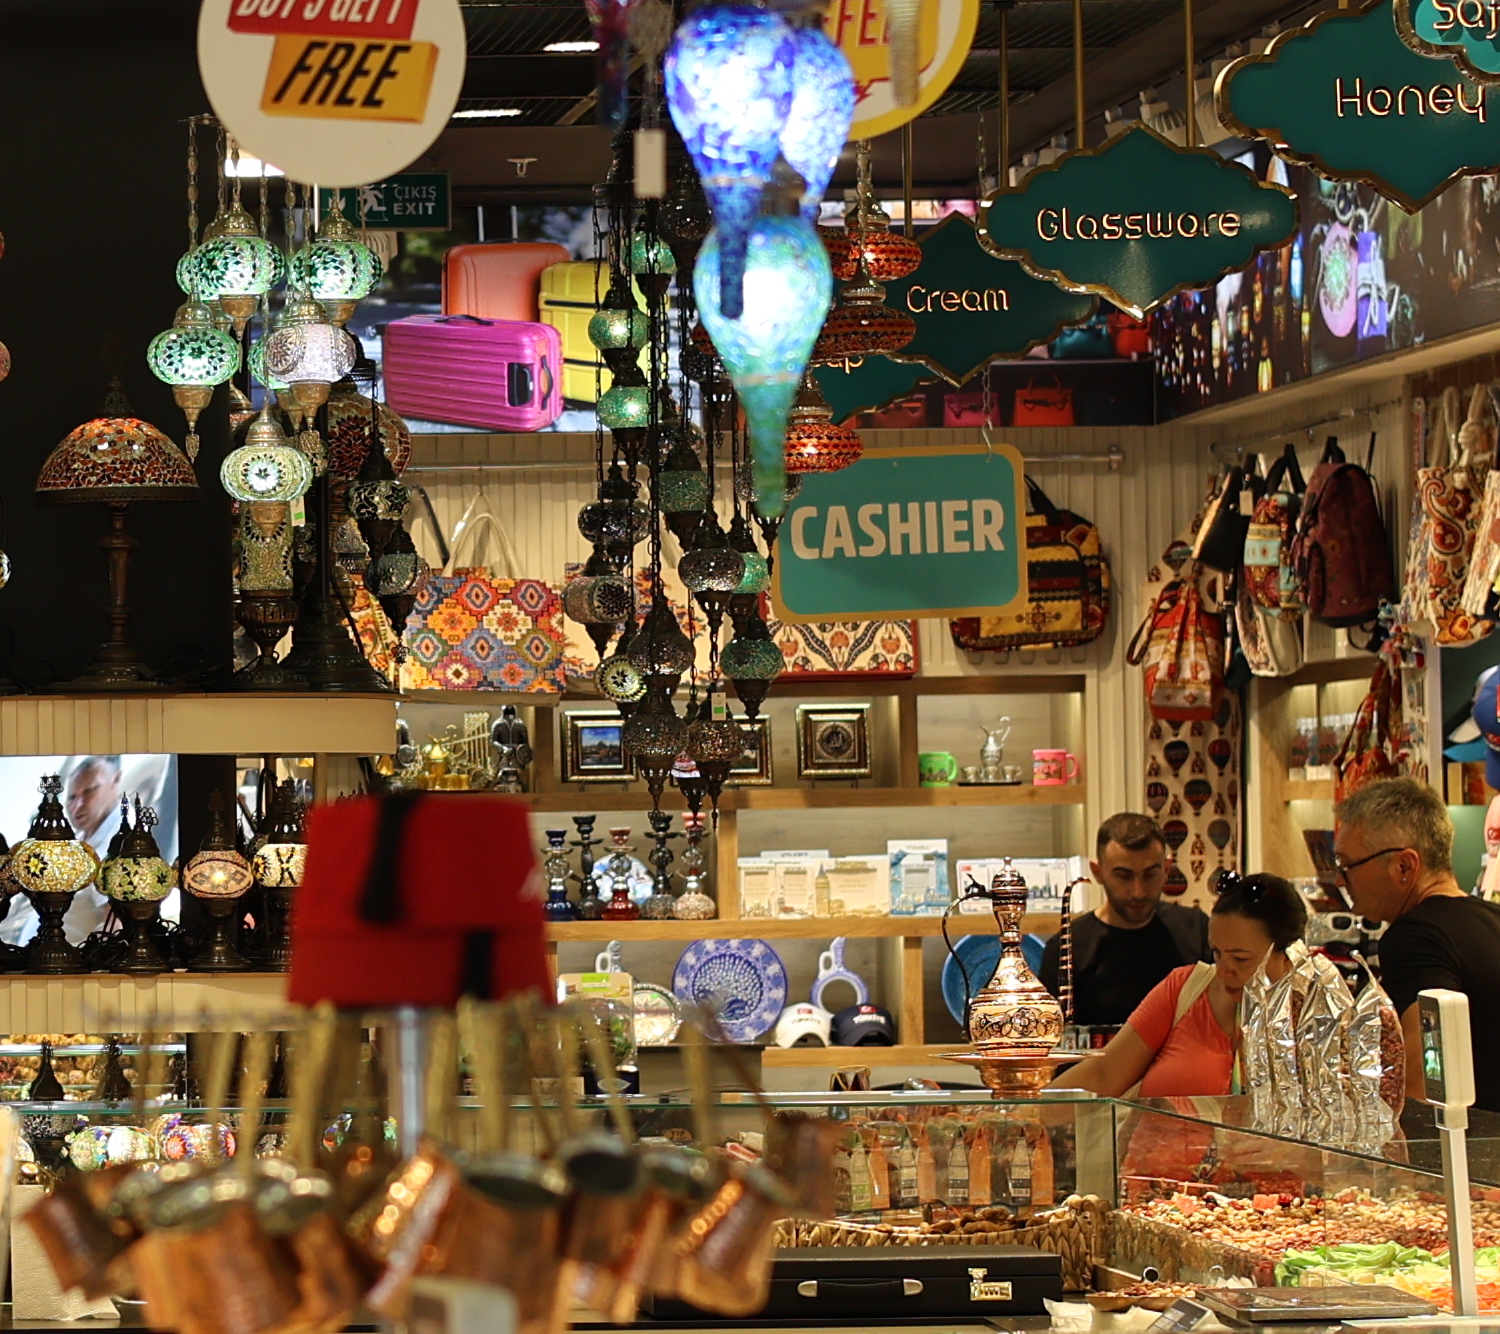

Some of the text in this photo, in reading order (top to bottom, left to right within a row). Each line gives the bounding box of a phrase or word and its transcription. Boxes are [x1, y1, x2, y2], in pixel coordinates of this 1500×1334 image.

[271, 40, 412, 109] FREE
[1335, 77, 1487, 124] Honey
[393, 201, 436, 216] EXIT
[395, 185, 436, 201] ÇIKIŞ
[1037, 207, 1242, 241] Glassware
[906, 285, 1009, 313] Cream
[790, 499, 1005, 560] CASHIER
